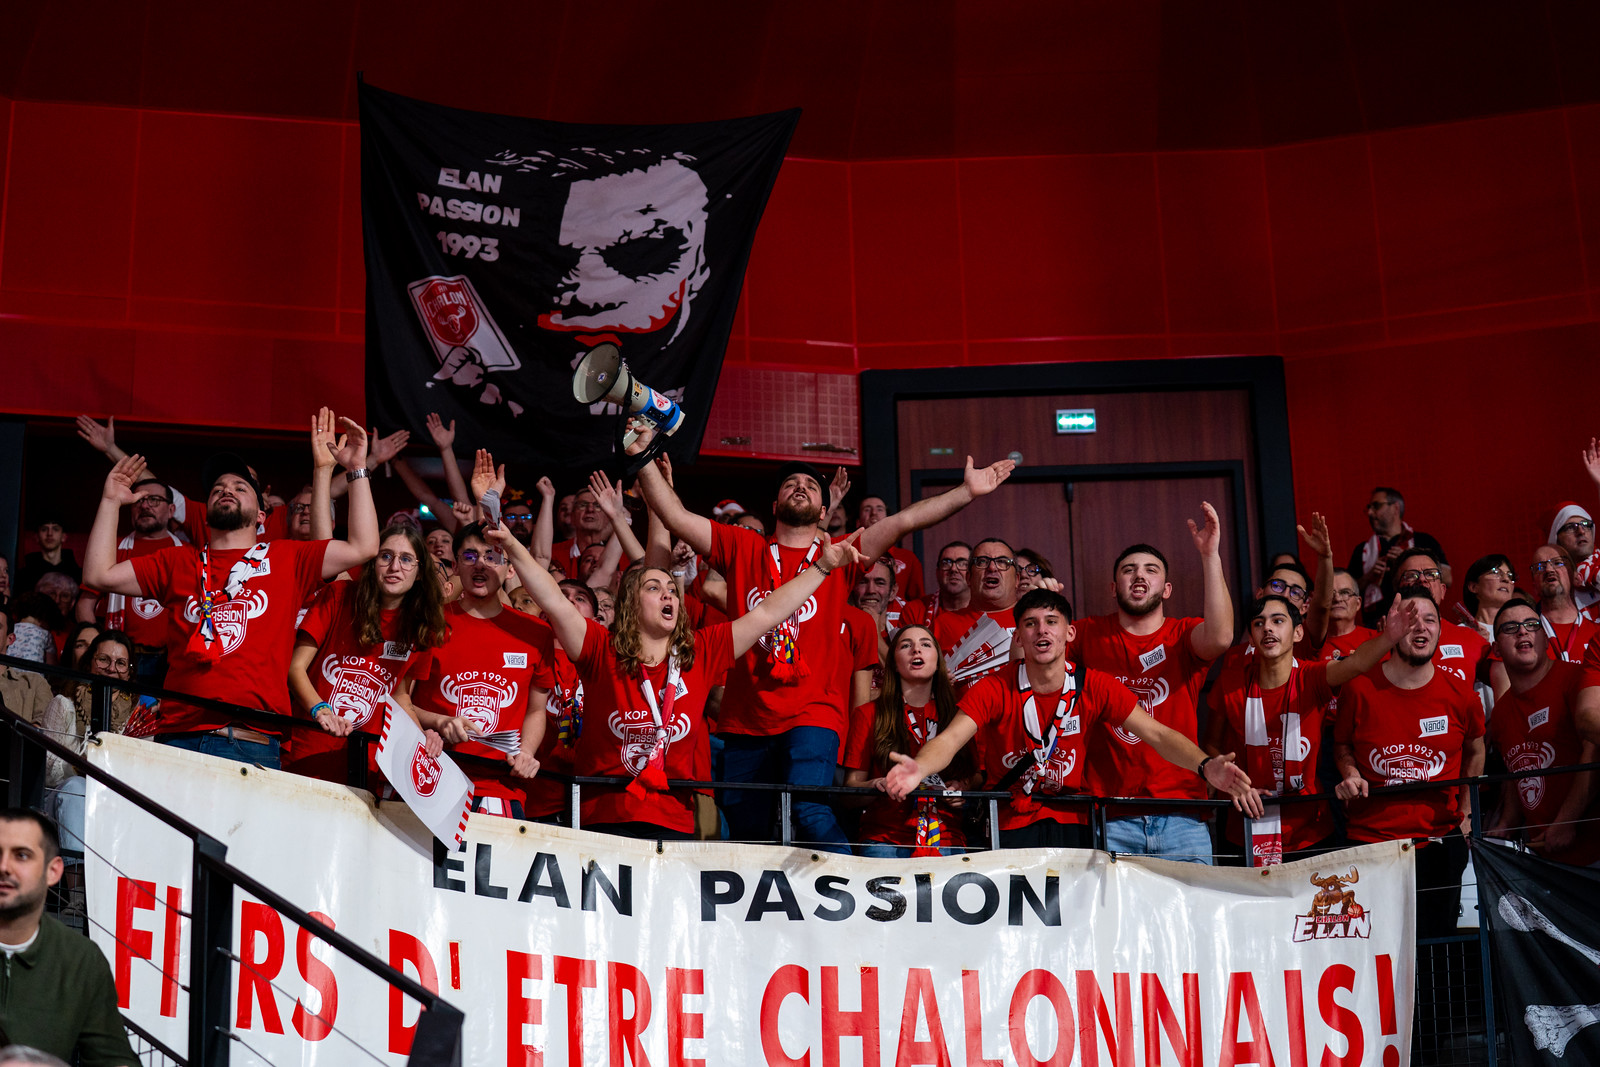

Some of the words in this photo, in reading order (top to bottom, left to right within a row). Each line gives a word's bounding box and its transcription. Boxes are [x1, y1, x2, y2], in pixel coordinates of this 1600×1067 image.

[438, 167, 502, 194] ELAN
[417, 192, 520, 227] PASSION
[436, 231, 500, 262] 1993
[427, 290, 467, 318] CHALON
[342, 655, 366, 666] KOP
[368, 661, 392, 681] 1993
[354, 674, 371, 687] ELAN
[457, 671, 479, 682] KOP
[482, 671, 508, 687] 1993
[338, 678, 377, 704] PASSION
[473, 687, 489, 696] ELAN
[1131, 677, 1154, 687] 1993
[462, 694, 498, 711] PASSION
[624, 710, 648, 720] KOP
[1383, 744, 1405, 755] KOP
[1408, 743, 1433, 758] 1993
[416, 750, 440, 783] CHALON
[1390, 767, 1427, 781] PASSION
[433, 836, 633, 917] ELAN
[700, 869, 1062, 926] PASSION
[1293, 908, 1371, 942] ELAN
[1315, 914, 1350, 924] CHALON
[115, 876, 339, 1041] FIRS
[506, 949, 707, 1067] ETRE
[760, 953, 1400, 1067] CHALONNAIS!
